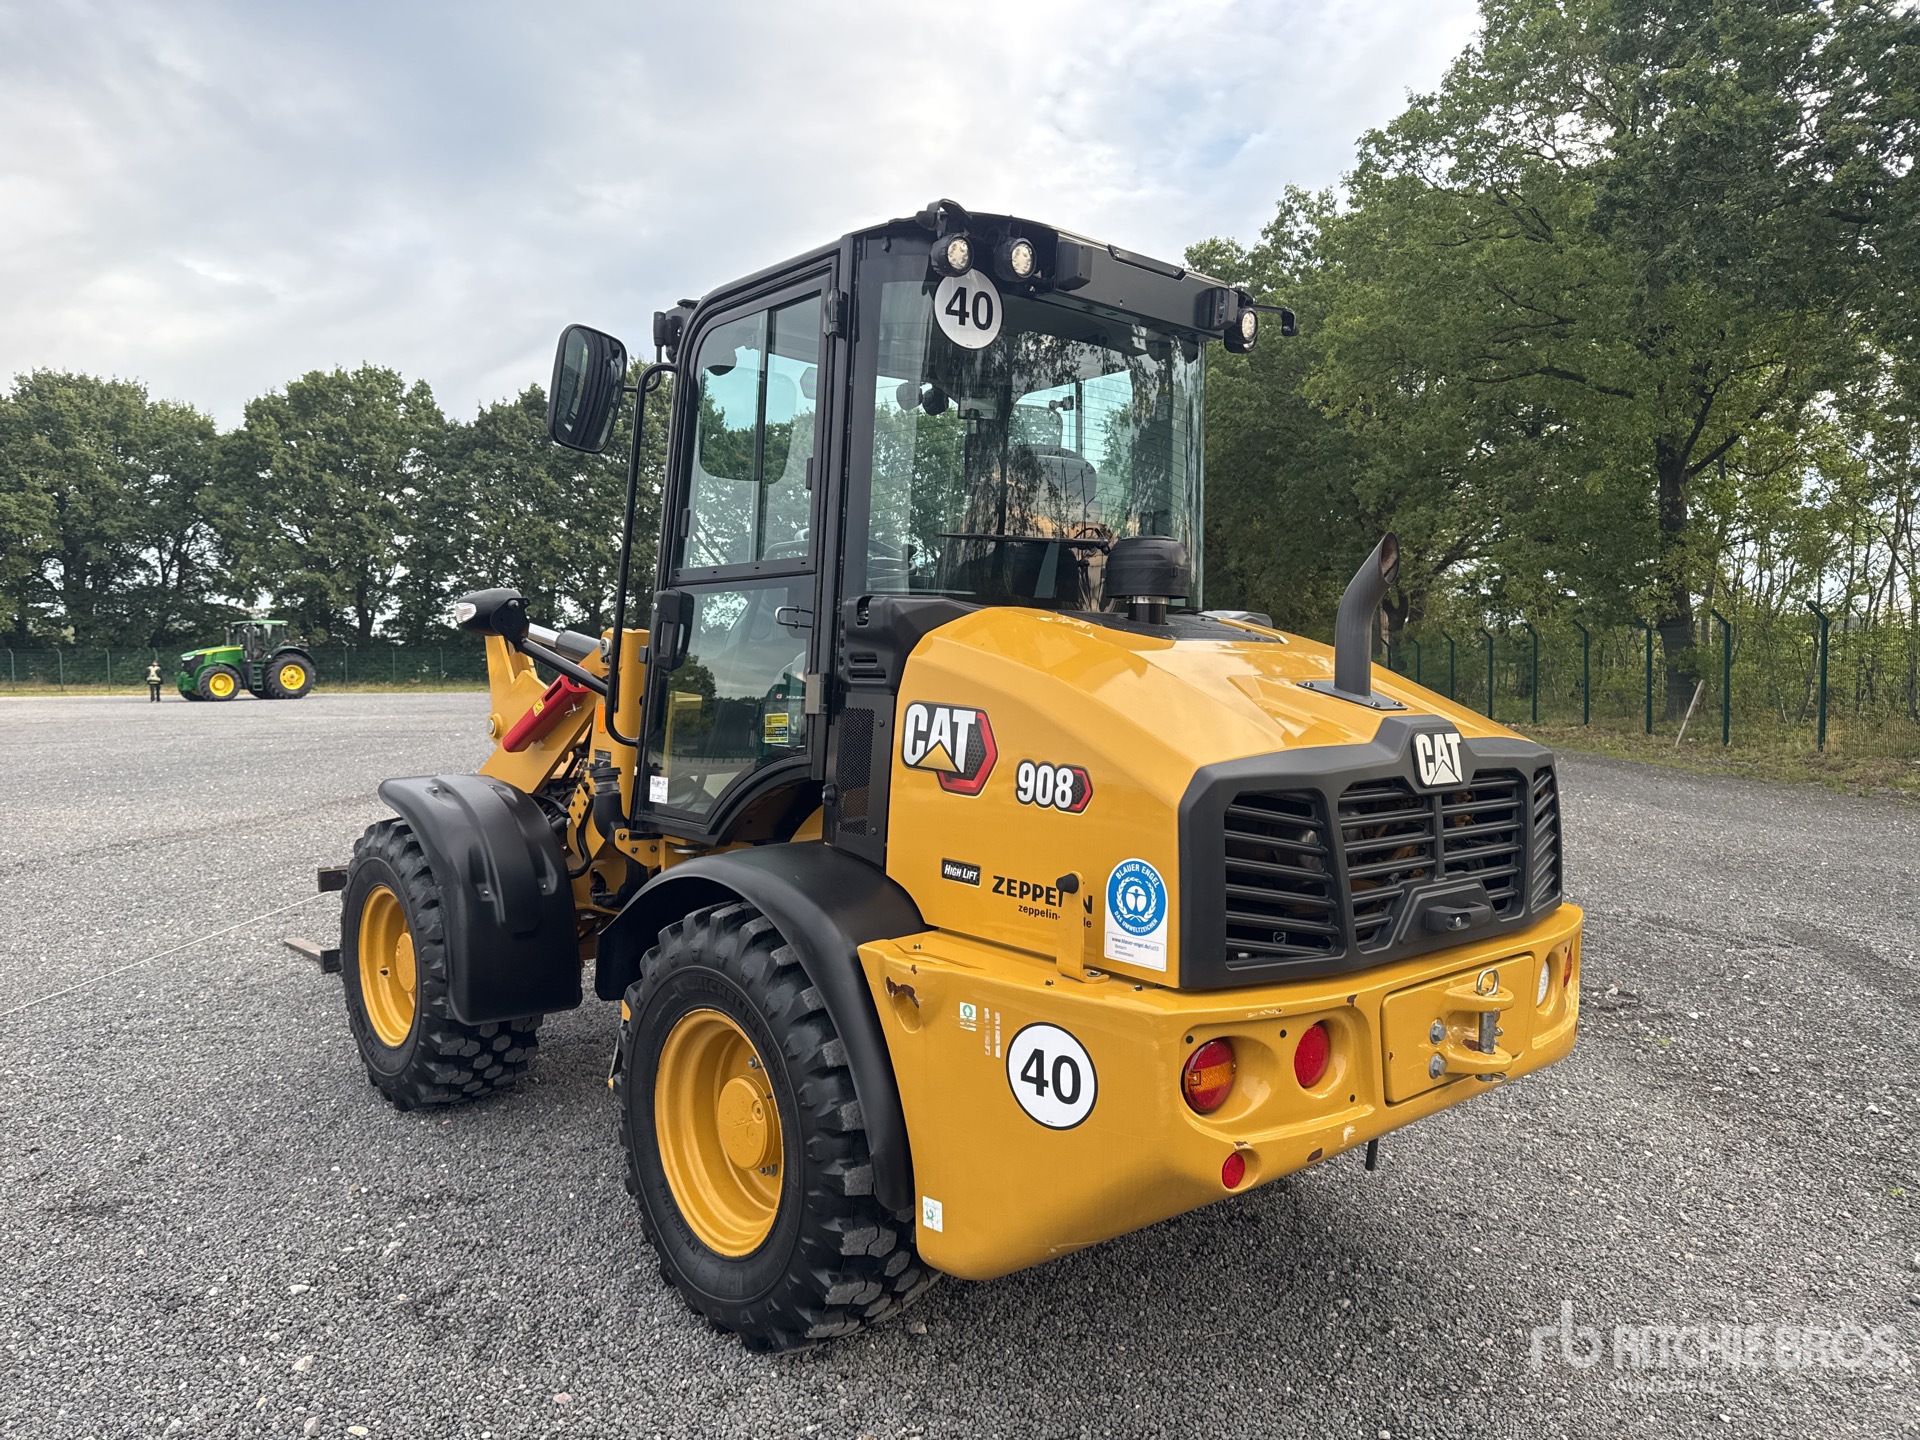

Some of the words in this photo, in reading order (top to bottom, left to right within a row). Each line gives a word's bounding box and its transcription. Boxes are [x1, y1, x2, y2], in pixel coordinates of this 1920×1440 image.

[945, 286, 994, 331] 40
[903, 703, 977, 774] CAT
[1415, 733, 1463, 786] CAT
[1017, 762, 1075, 809] 908
[992, 875, 1093, 915] ZEPPEN
[1115, 863, 1140, 880] BLAUER
[1141, 866, 1160, 889] ENGEL
[1020, 1048, 1081, 1105] 40
